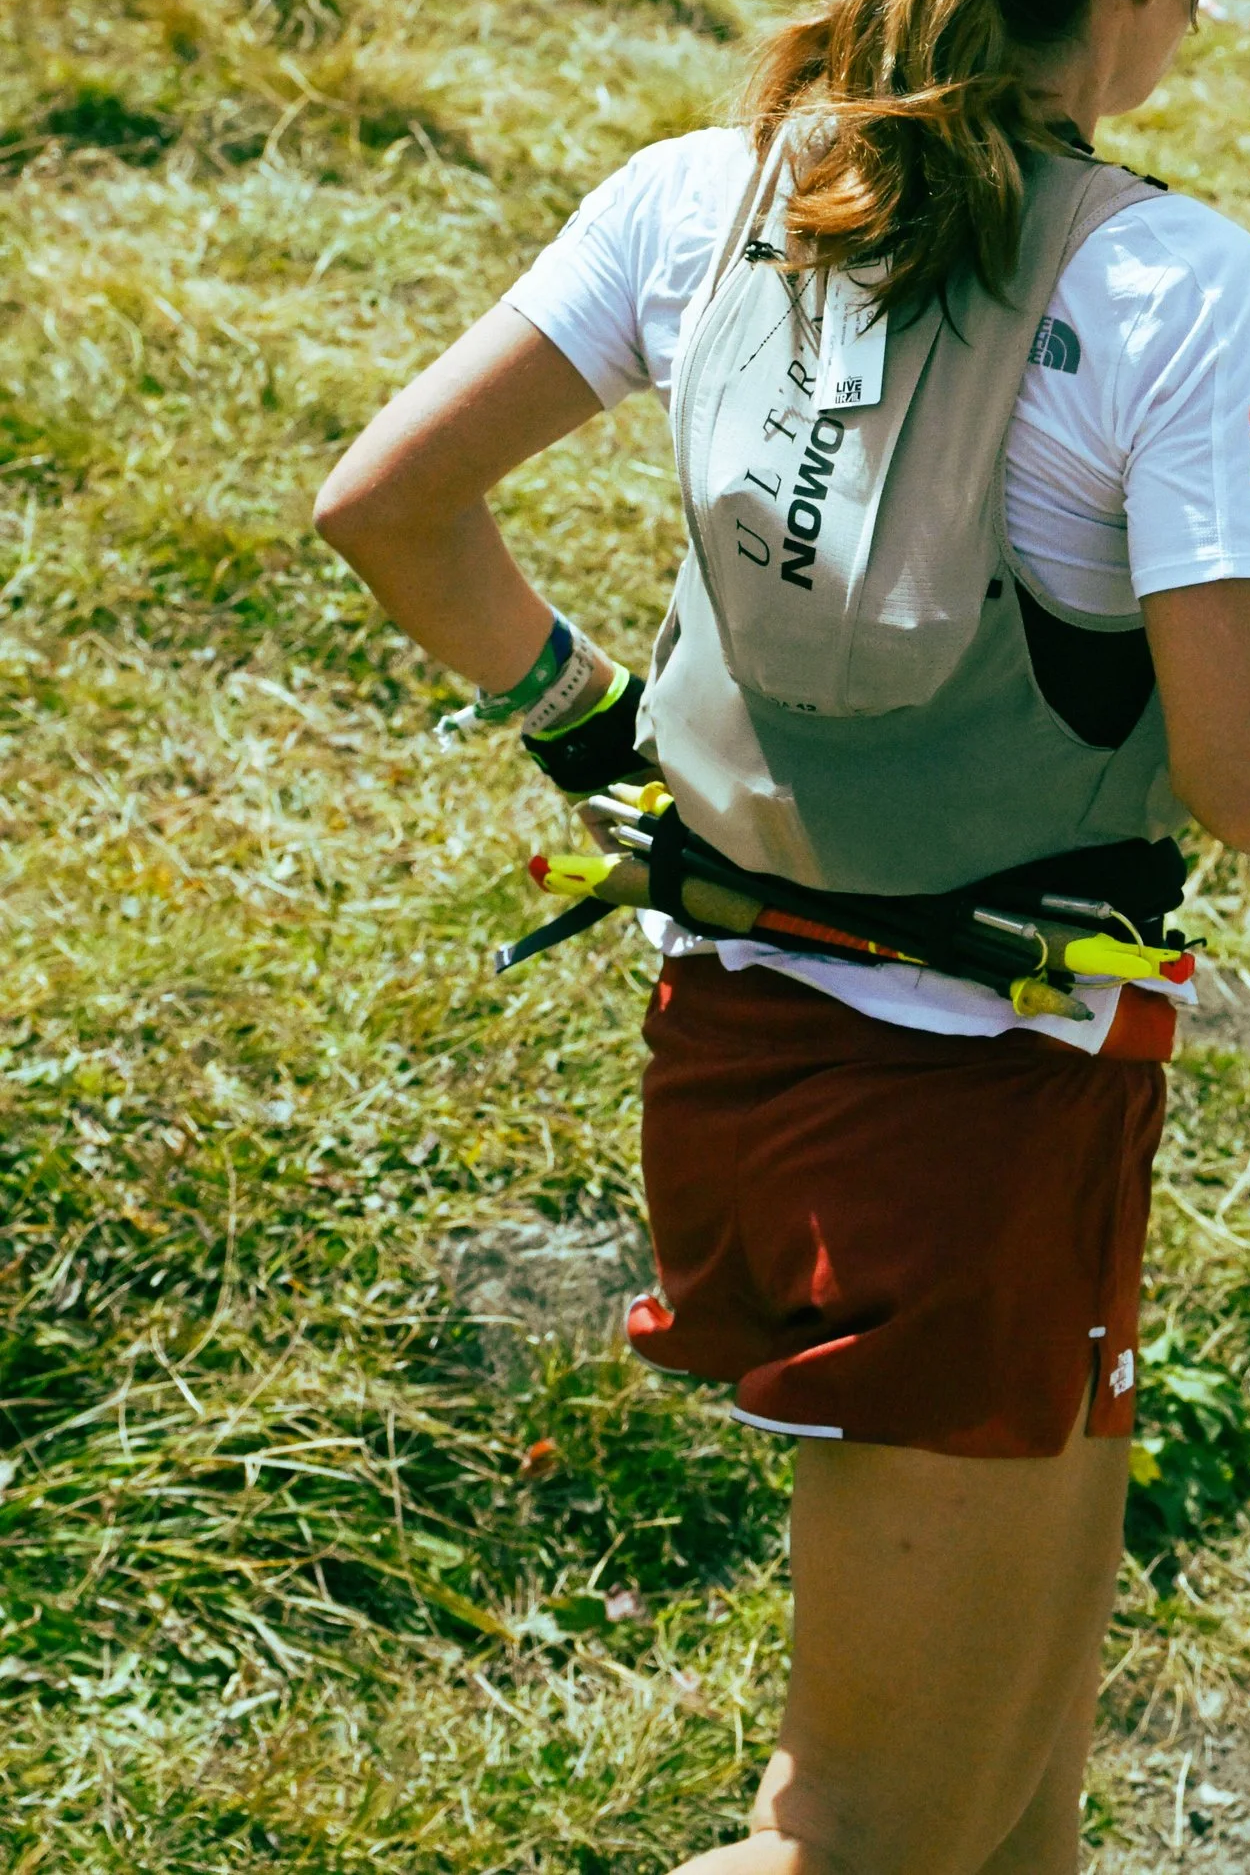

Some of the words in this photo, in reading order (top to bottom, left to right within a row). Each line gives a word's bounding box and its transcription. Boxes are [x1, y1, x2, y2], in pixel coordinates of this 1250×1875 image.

[836, 379, 862, 393] LIVE
[835, 391, 861, 404] TRAIL
[781, 416, 845, 592] OMON
